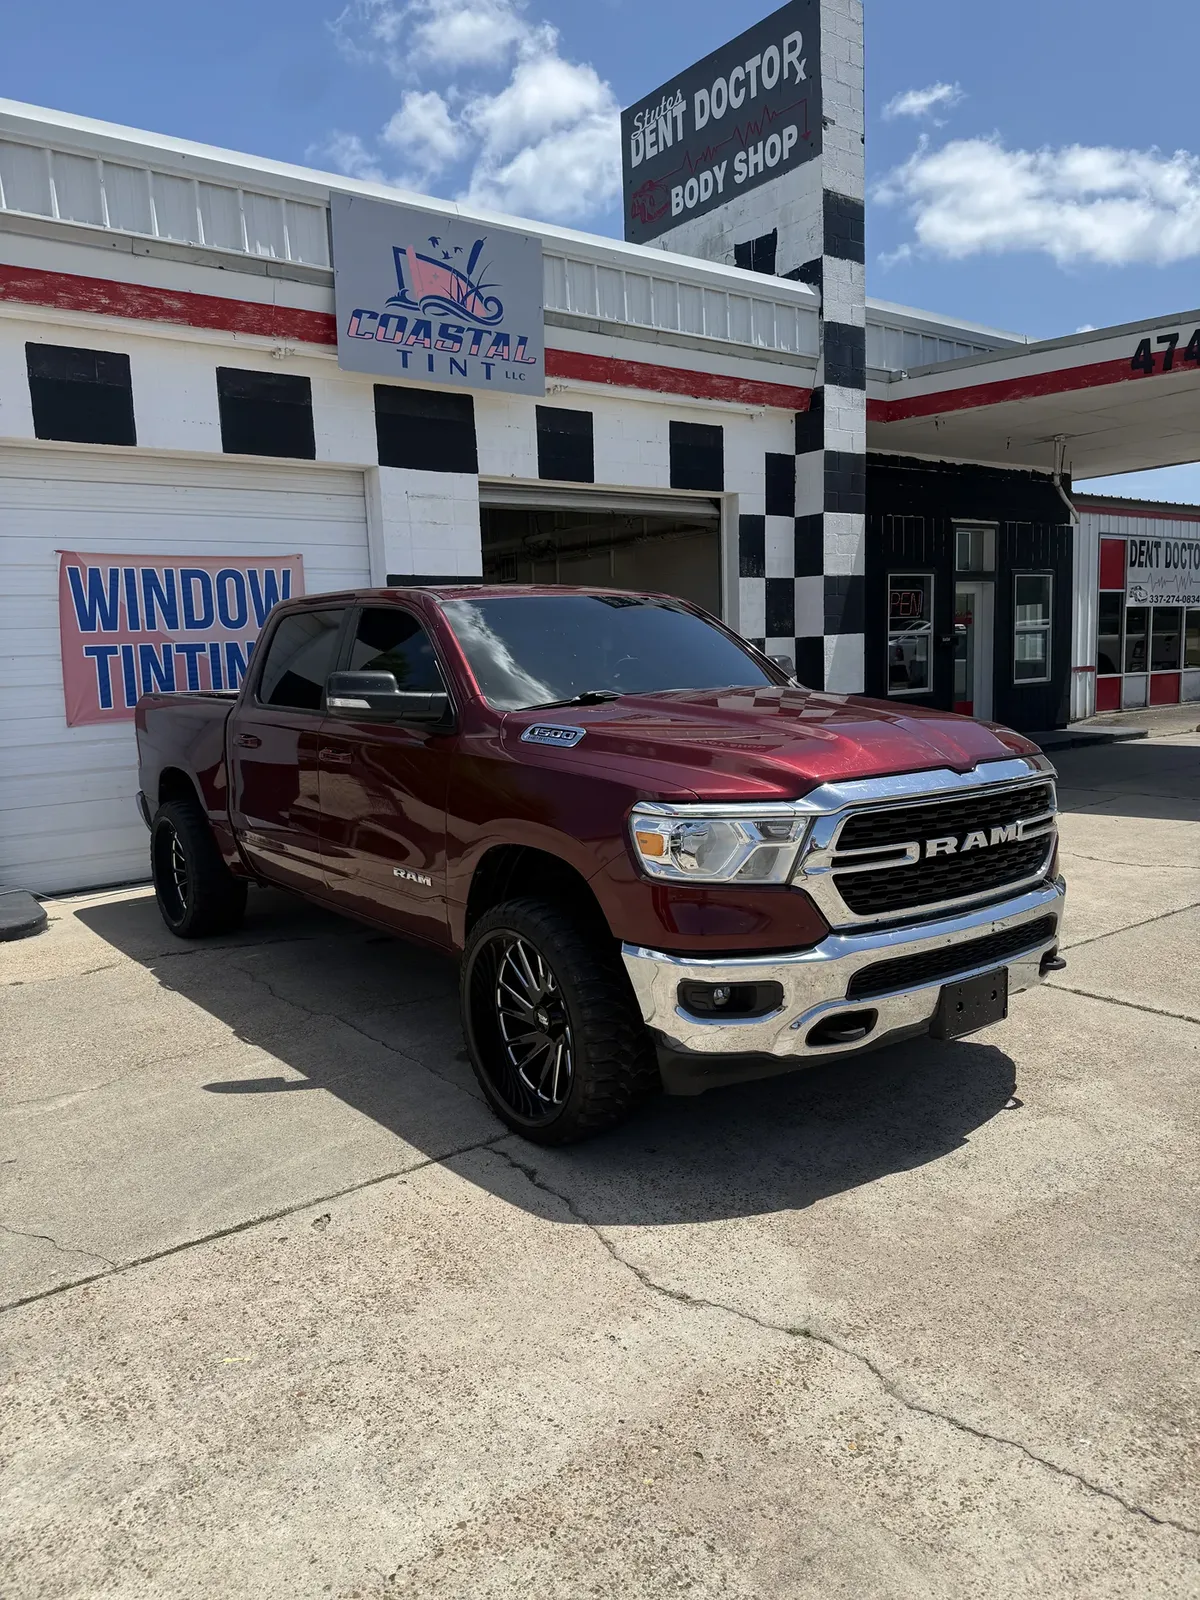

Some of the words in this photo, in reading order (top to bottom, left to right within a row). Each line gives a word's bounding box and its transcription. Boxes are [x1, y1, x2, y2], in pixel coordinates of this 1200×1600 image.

[631, 99, 687, 168] DENT
[671, 160, 728, 217] BODY
[734, 125, 798, 184] SHOP
[347, 308, 537, 365] COASTAL
[396, 349, 496, 380] TINT
[505, 370, 526, 381] LLC
[1129, 540, 1162, 568] DENT
[1165, 542, 1200, 570] DOCTO
[66, 566, 292, 632] WINDOW
[890, 592, 920, 616] PEN
[83, 641, 256, 709] TINTIN
[531, 727, 576, 740] 1500
[926, 823, 1017, 858] RAM
[393, 867, 432, 887] RAM
